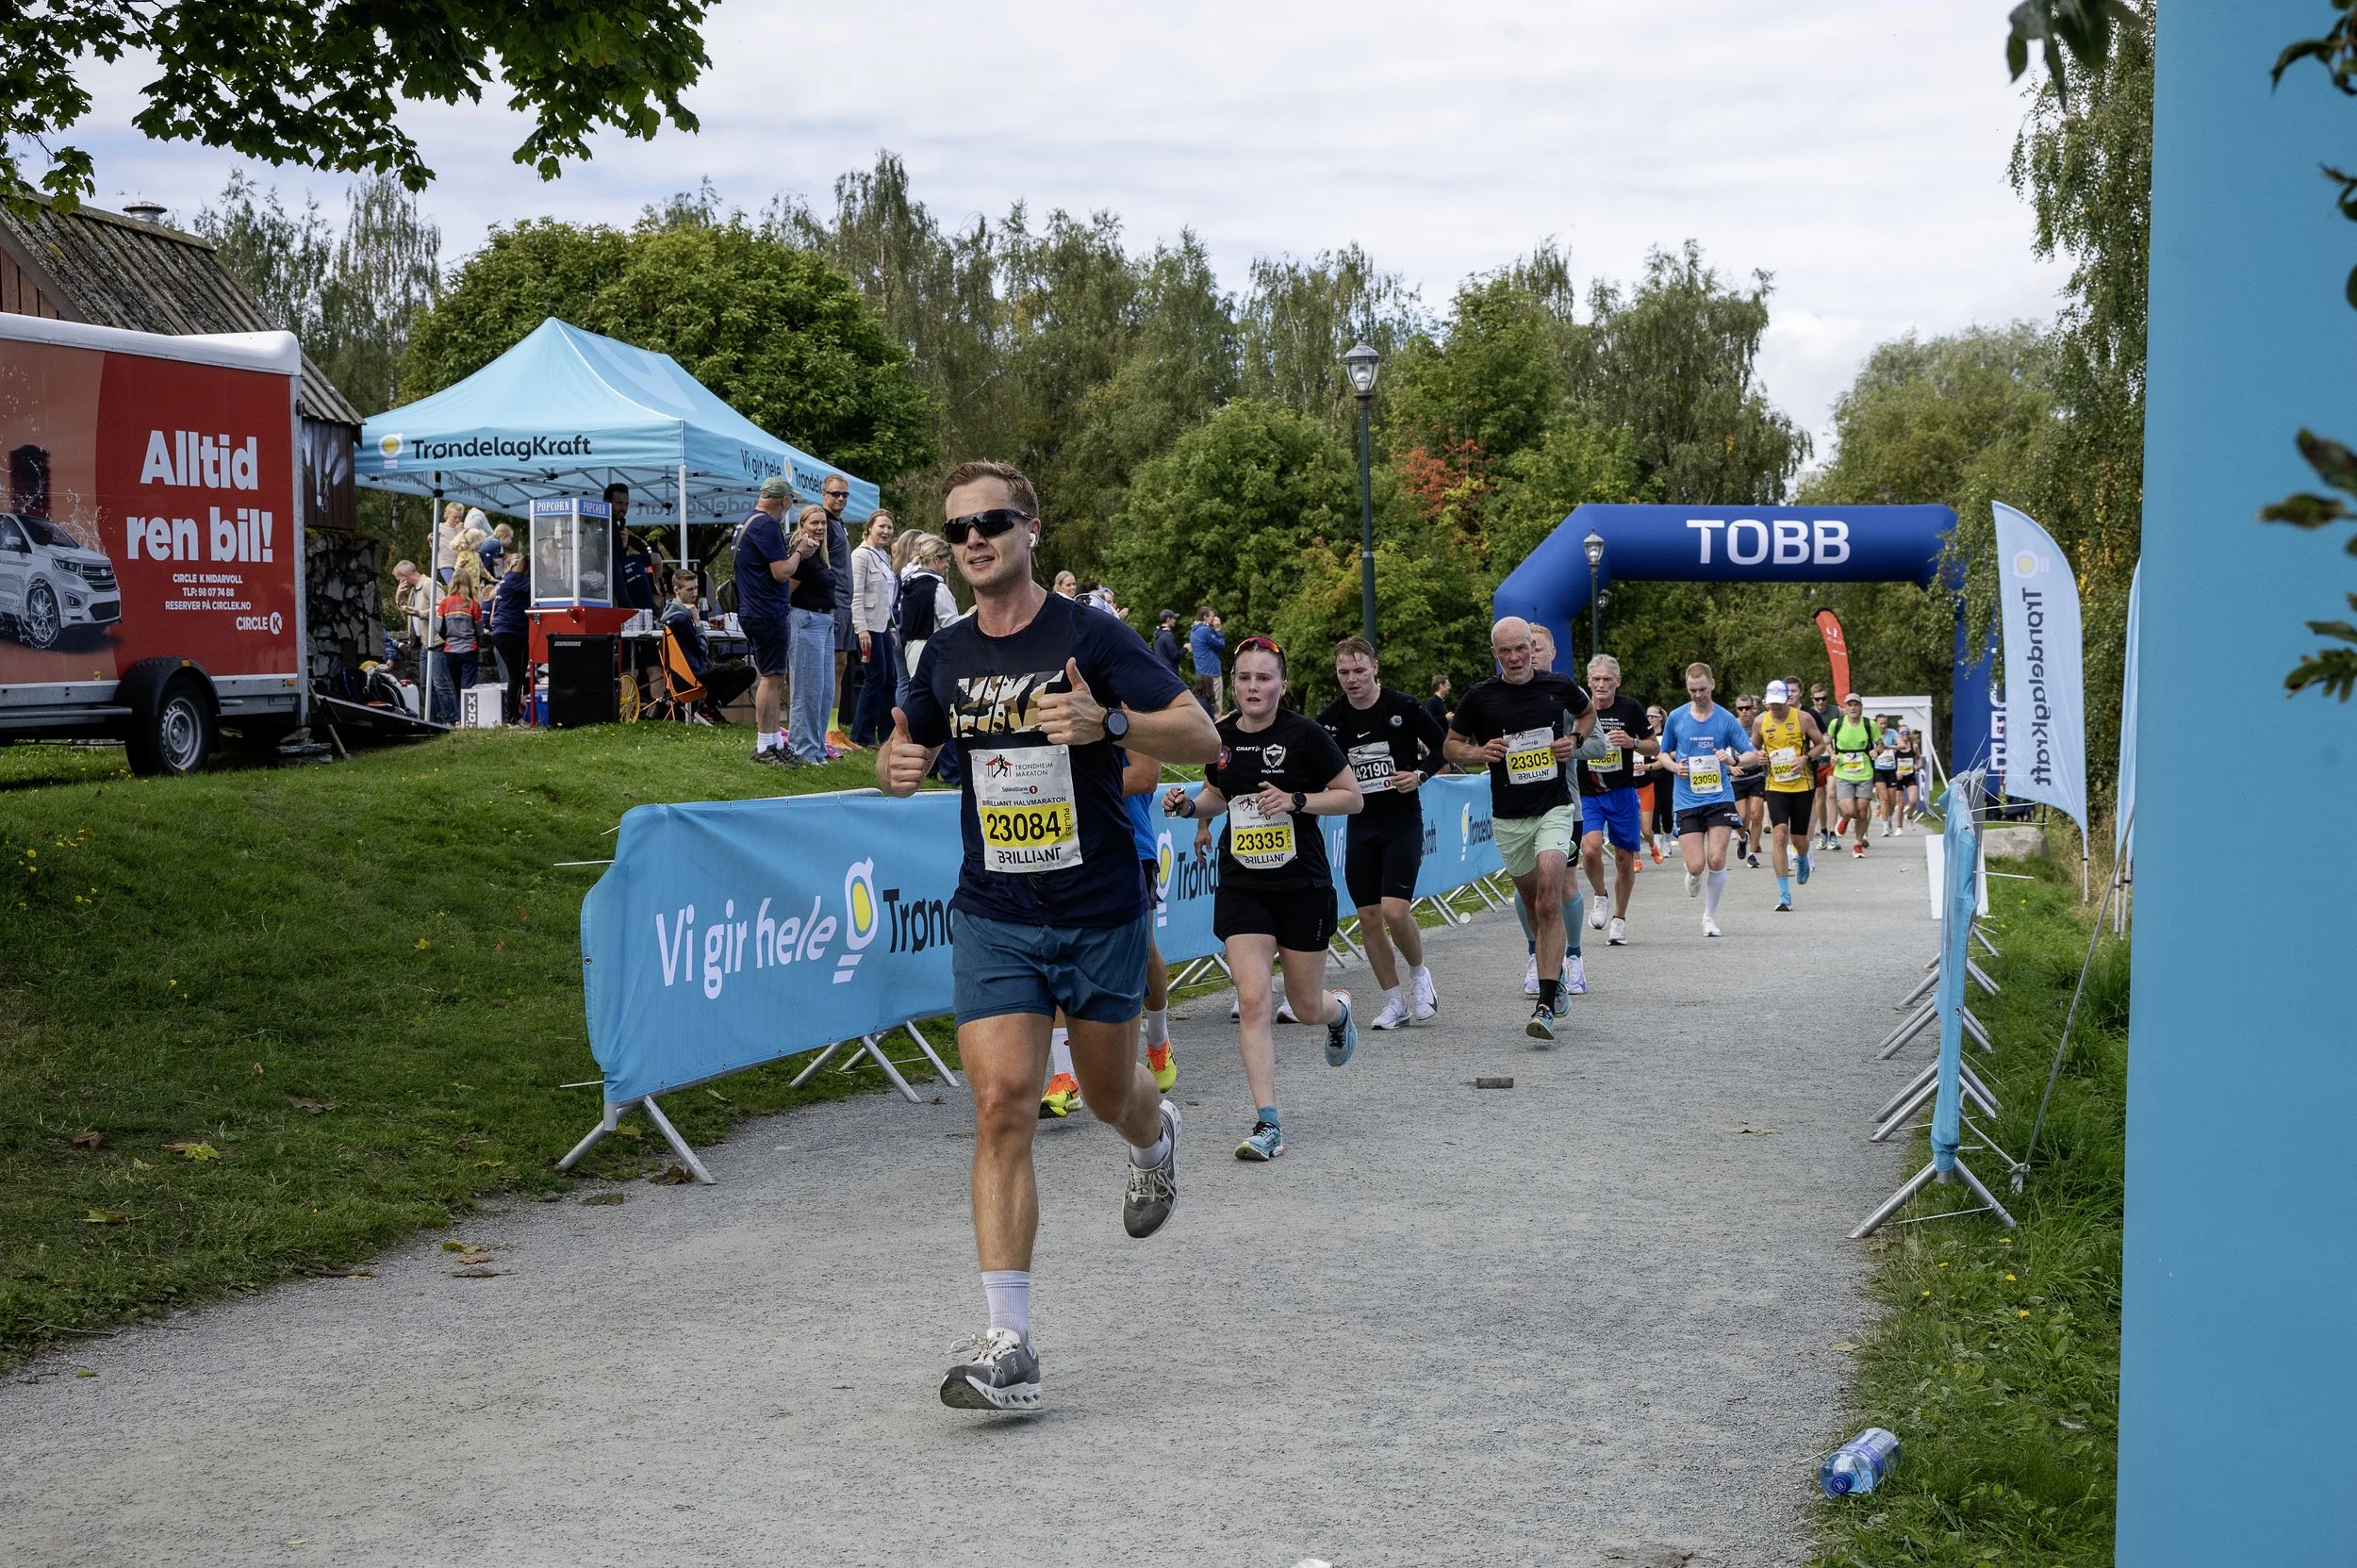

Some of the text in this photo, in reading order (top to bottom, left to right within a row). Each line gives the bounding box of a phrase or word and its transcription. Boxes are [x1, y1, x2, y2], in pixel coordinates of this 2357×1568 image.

[411, 435, 592, 462] TrøndelagKraft
[140, 430, 258, 490] Alltid
[740, 448, 751, 473] Vi
[752, 454, 763, 481] gir
[764, 456, 782, 478] hele
[536, 501, 569, 512] POPCORN
[583, 501, 605, 515] POPCORN
[126, 506, 273, 563] ren bil!
[1686, 520, 1851, 565] TOBB
[173, 573, 243, 584] CIRCLE K NIDARVOLL
[183, 587, 197, 597] TLF:
[207, 588, 216, 597] 07
[217, 588, 225, 597] 74
[165, 600, 252, 611] RESERVER PÅ CIRCLEK.NO
[236, 614, 282, 634] CIRCLE K
[1014, 762, 1054, 770] TRONDHEIM
[1510, 751, 1549, 770] 23305
[1773, 765, 1791, 774] 2306
[1356, 762, 1390, 781] 42190
[1517, 768, 1550, 781] BRILLIANT
[1692, 774, 1718, 785] 23090
[1360, 781, 1383, 790] SpareBank
[1014, 796, 1066, 806] HALVMARATON
[986, 811, 1062, 842] 23084
[1063, 807, 1072, 832] PULJE
[1236, 831, 1285, 851] 23335
[1333, 827, 1343, 868] Vi
[996, 847, 1062, 865] BRILLIANT
[1243, 852, 1285, 865] BRILLIANT
[655, 904, 695, 988] Vi
[703, 899, 748, 1000] gir
[755, 895, 837, 969] hele
